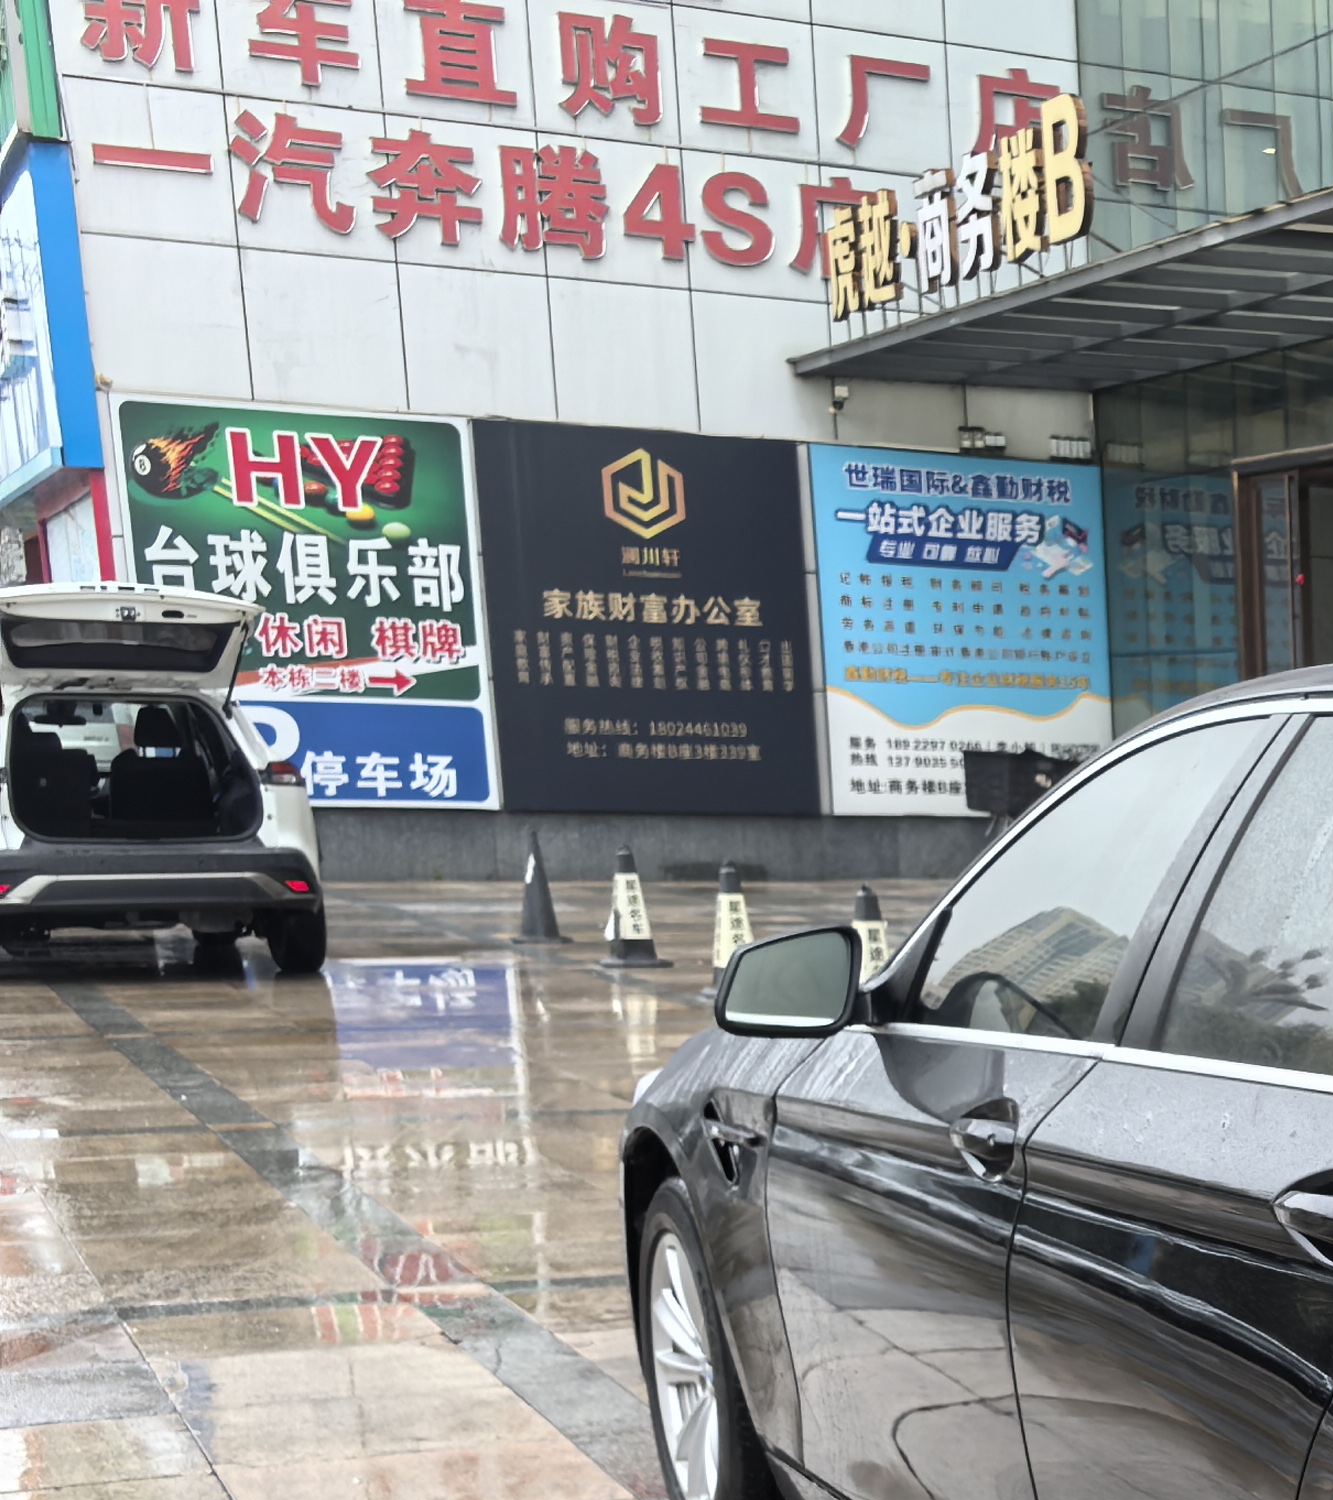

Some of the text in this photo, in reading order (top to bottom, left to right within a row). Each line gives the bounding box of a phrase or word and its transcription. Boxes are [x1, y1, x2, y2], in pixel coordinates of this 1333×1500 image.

[225, 427, 382, 511] HY
[836, 500, 1044, 545] 一站式企业服务
[144, 525, 464, 611] 台球俱乐部
[543, 588, 763, 627] 家族财富办公室
[257, 614, 347, 658] 休闲
[373, 619, 465, 663] 棋牌
[300, 751, 457, 797] 停车场
